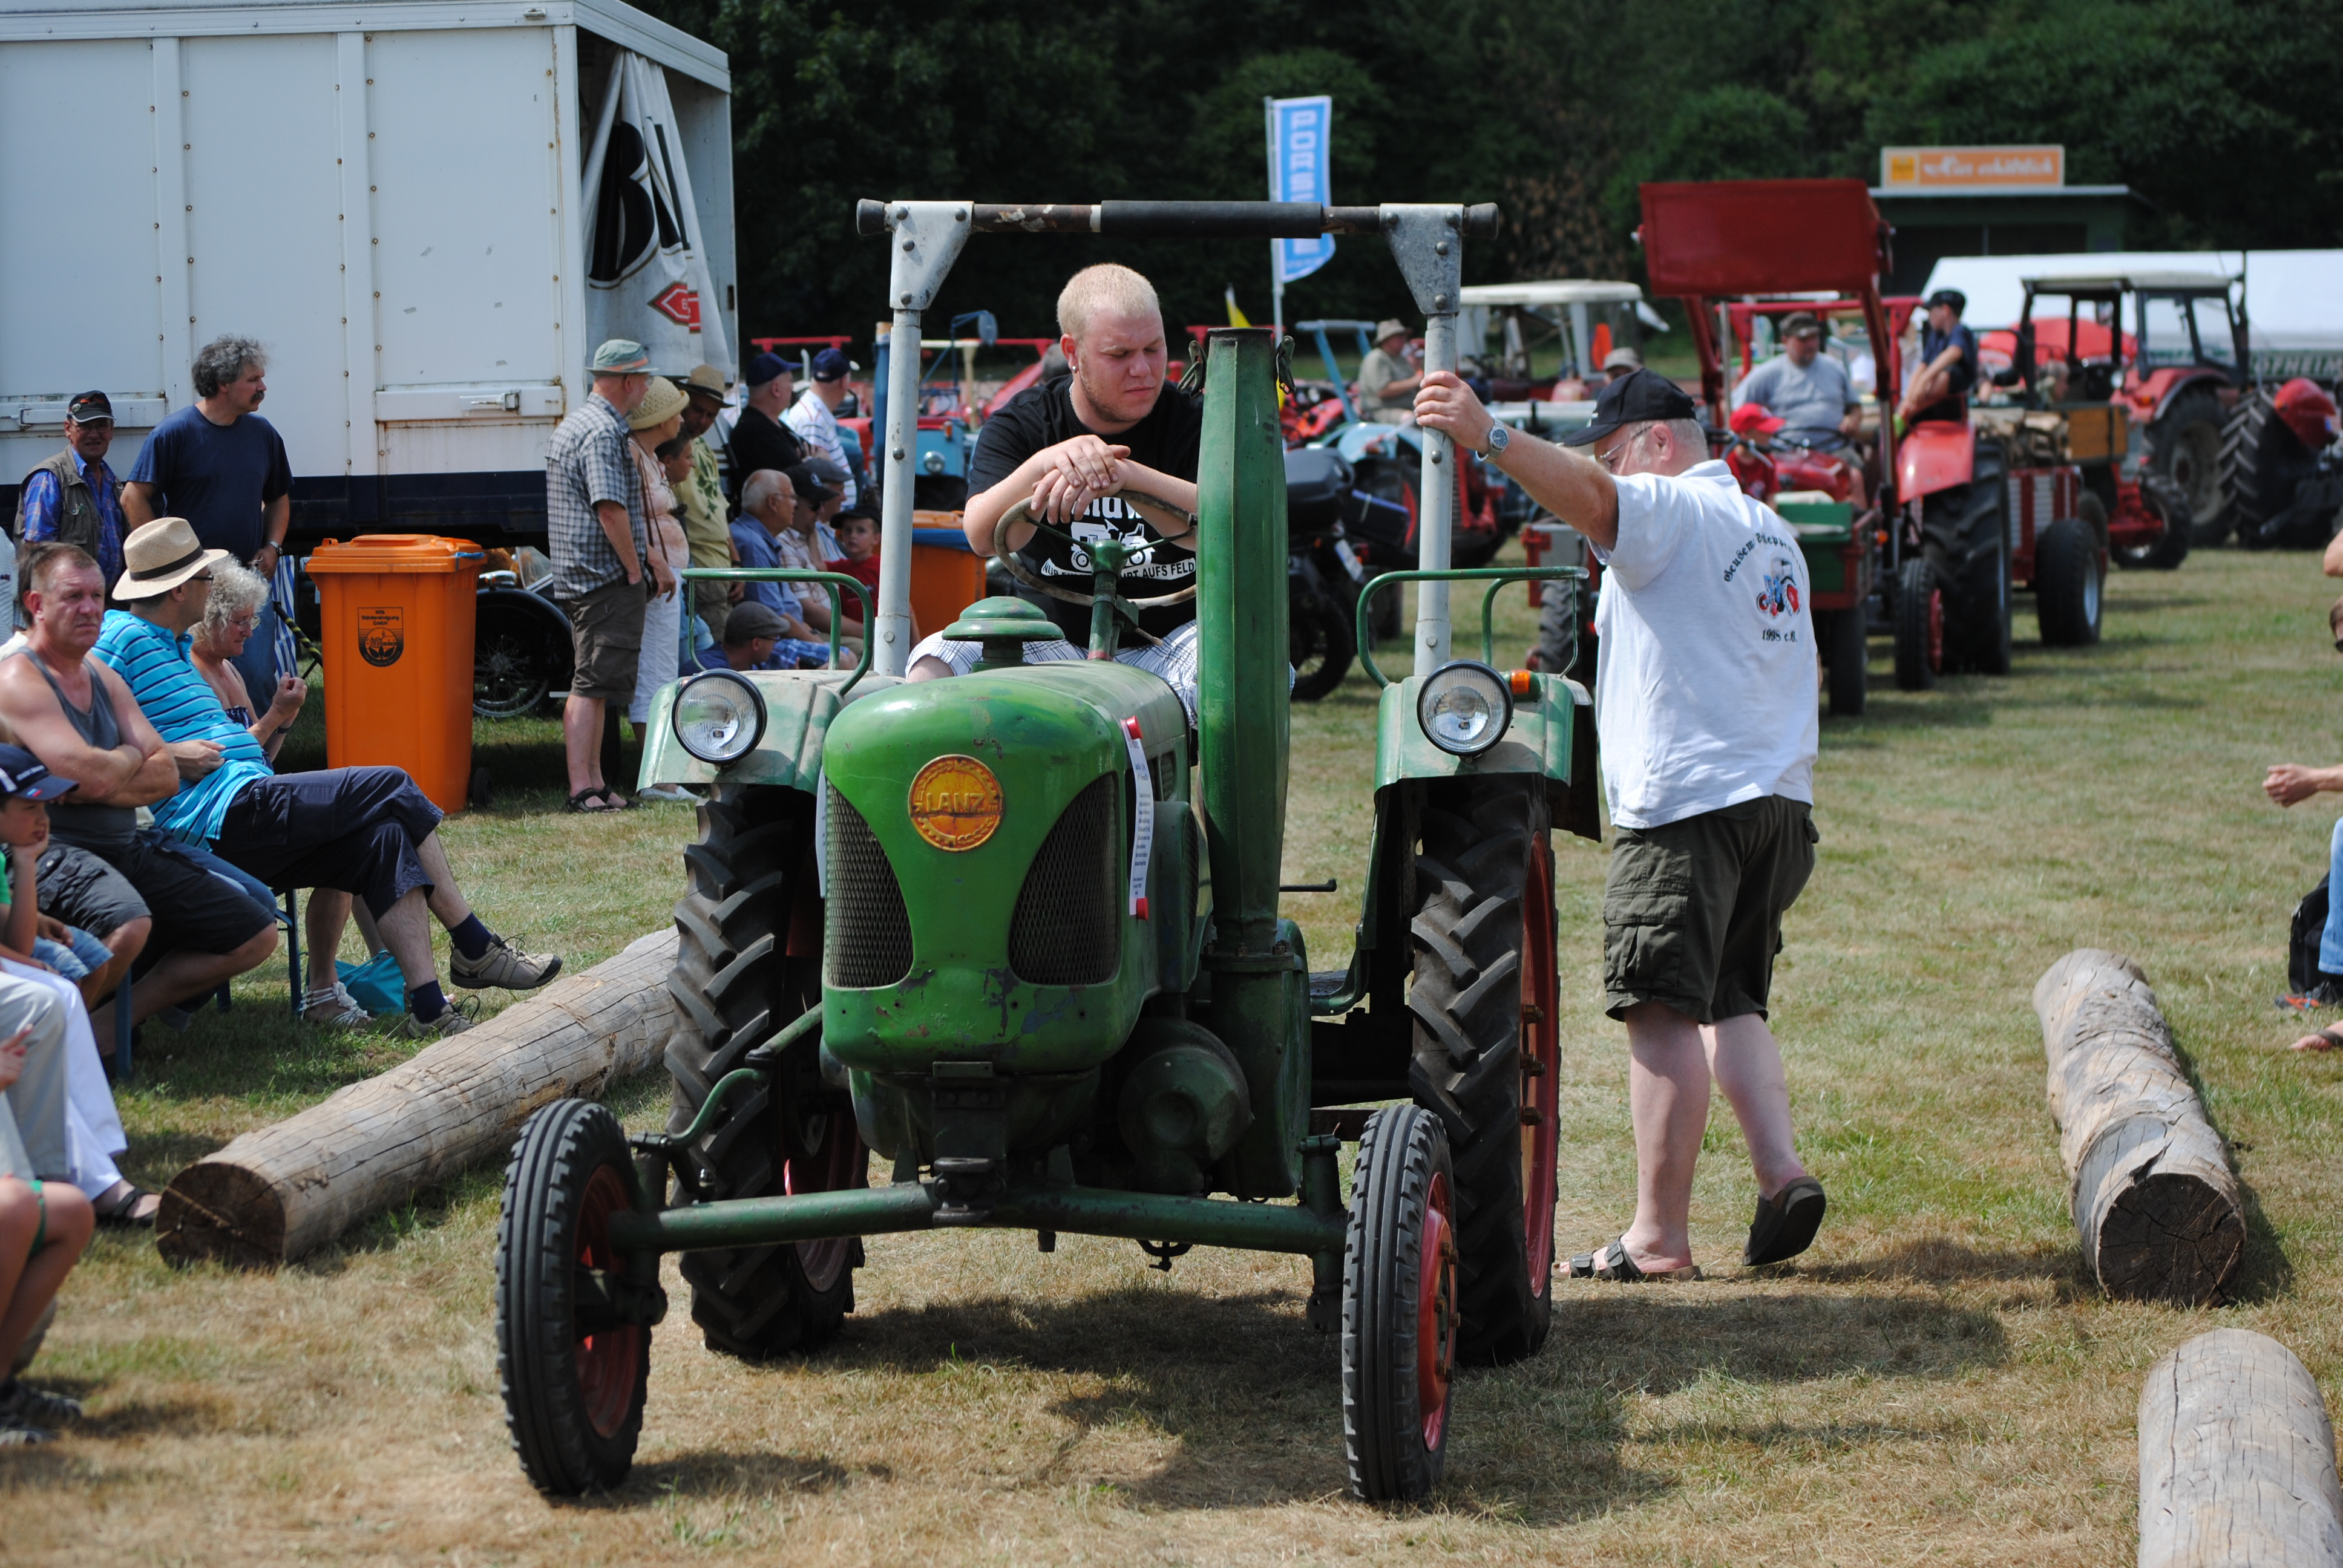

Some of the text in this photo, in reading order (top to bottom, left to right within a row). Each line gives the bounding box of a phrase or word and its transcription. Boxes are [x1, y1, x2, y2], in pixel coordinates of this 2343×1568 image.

[1142, 565, 1168, 578] AUFS
[1171, 562, 1194, 575] FELD
[1761, 629, 1781, 641] 1998
[926, 792, 985, 813] LANZ
